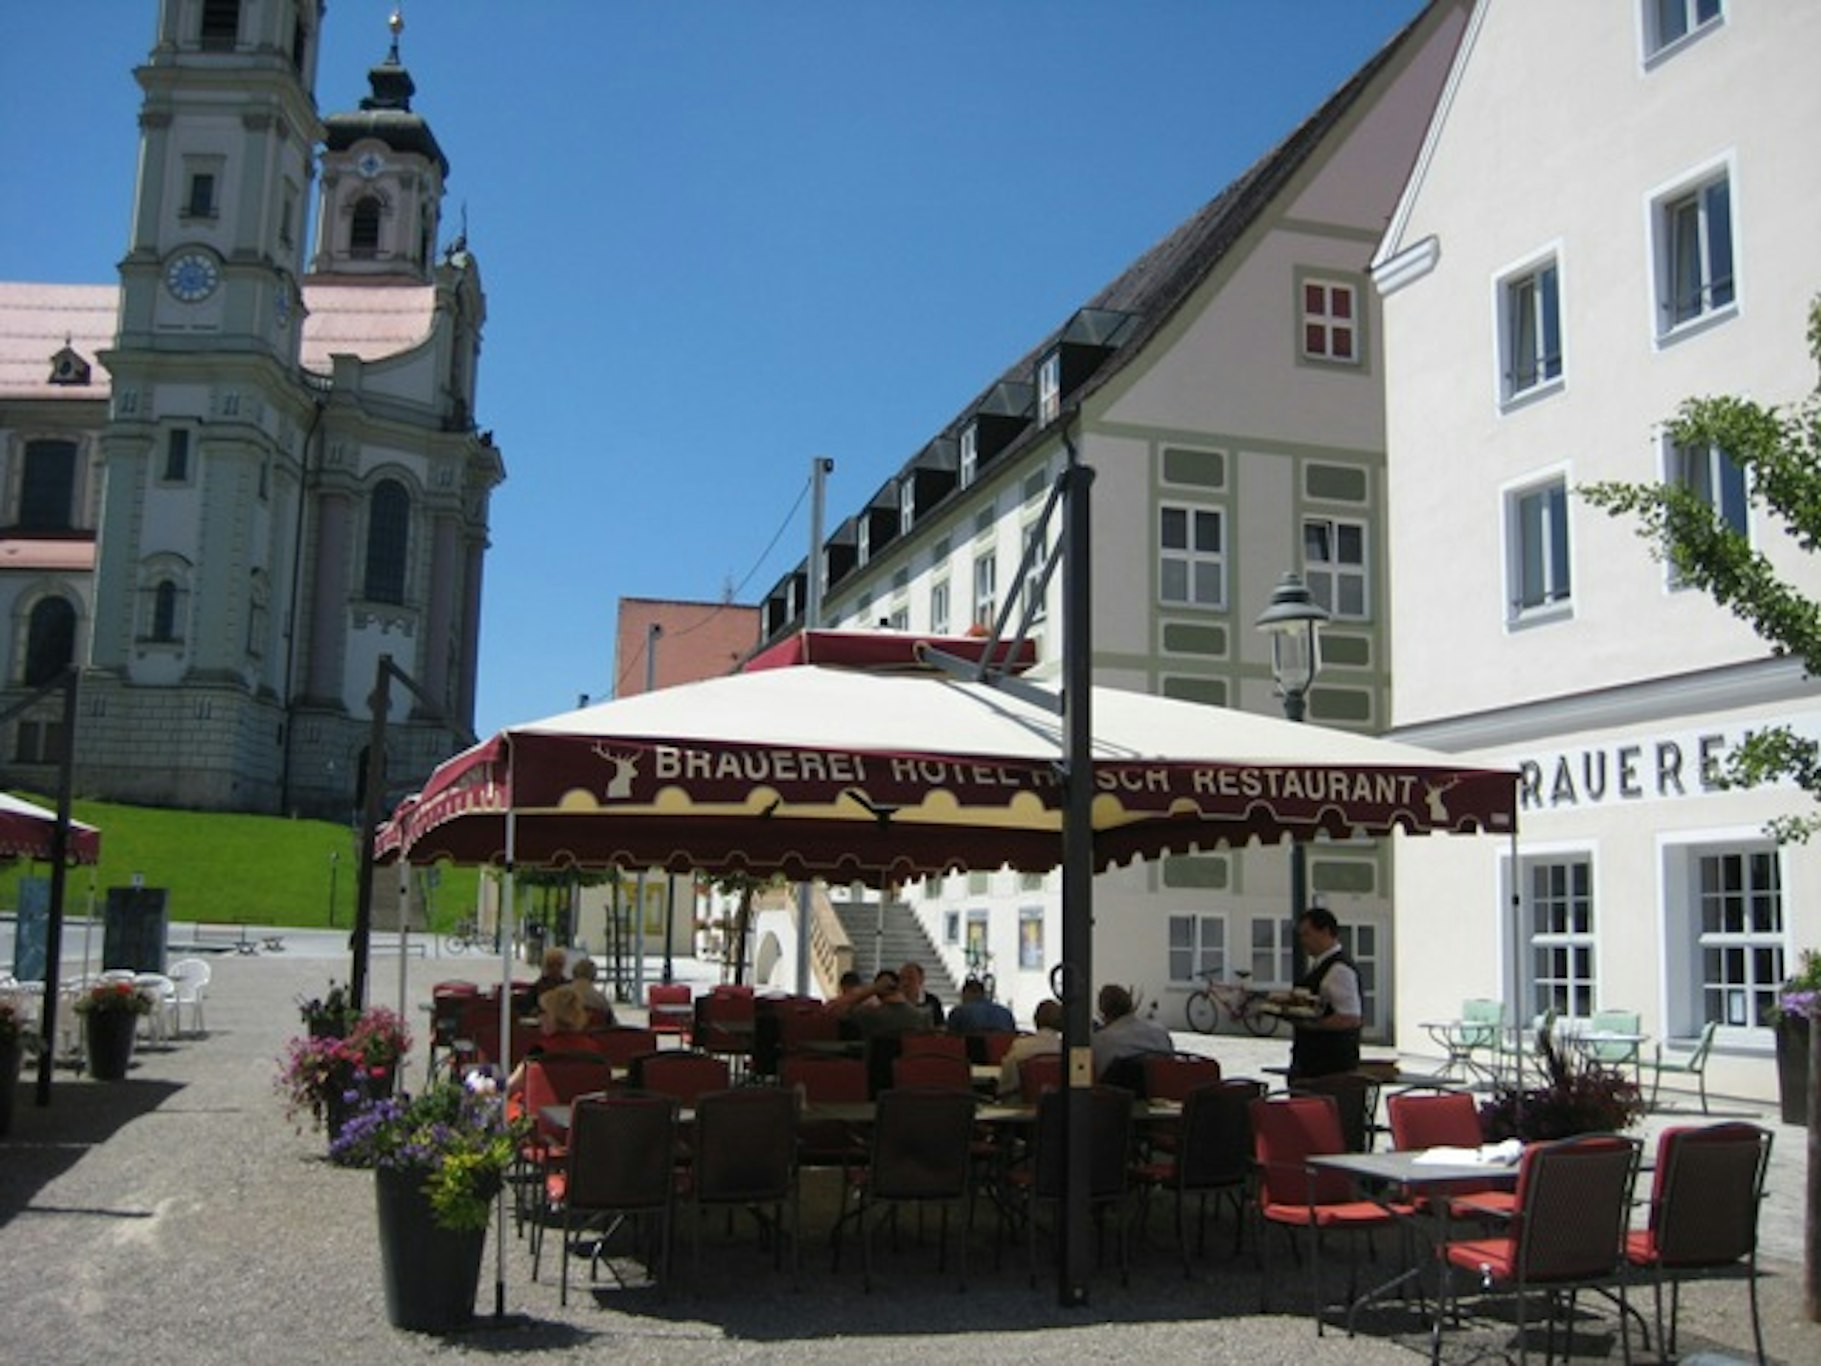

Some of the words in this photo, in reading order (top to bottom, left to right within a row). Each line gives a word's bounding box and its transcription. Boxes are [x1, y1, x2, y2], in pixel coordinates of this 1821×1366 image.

[655, 745, 867, 782] BRAUEREI
[890, 757, 1020, 785] HOTEL
[1031, 768, 1170, 792] HSCH
[1193, 768, 1418, 804] RESTAURANT
[1519, 731, 1754, 811] RAUERE
